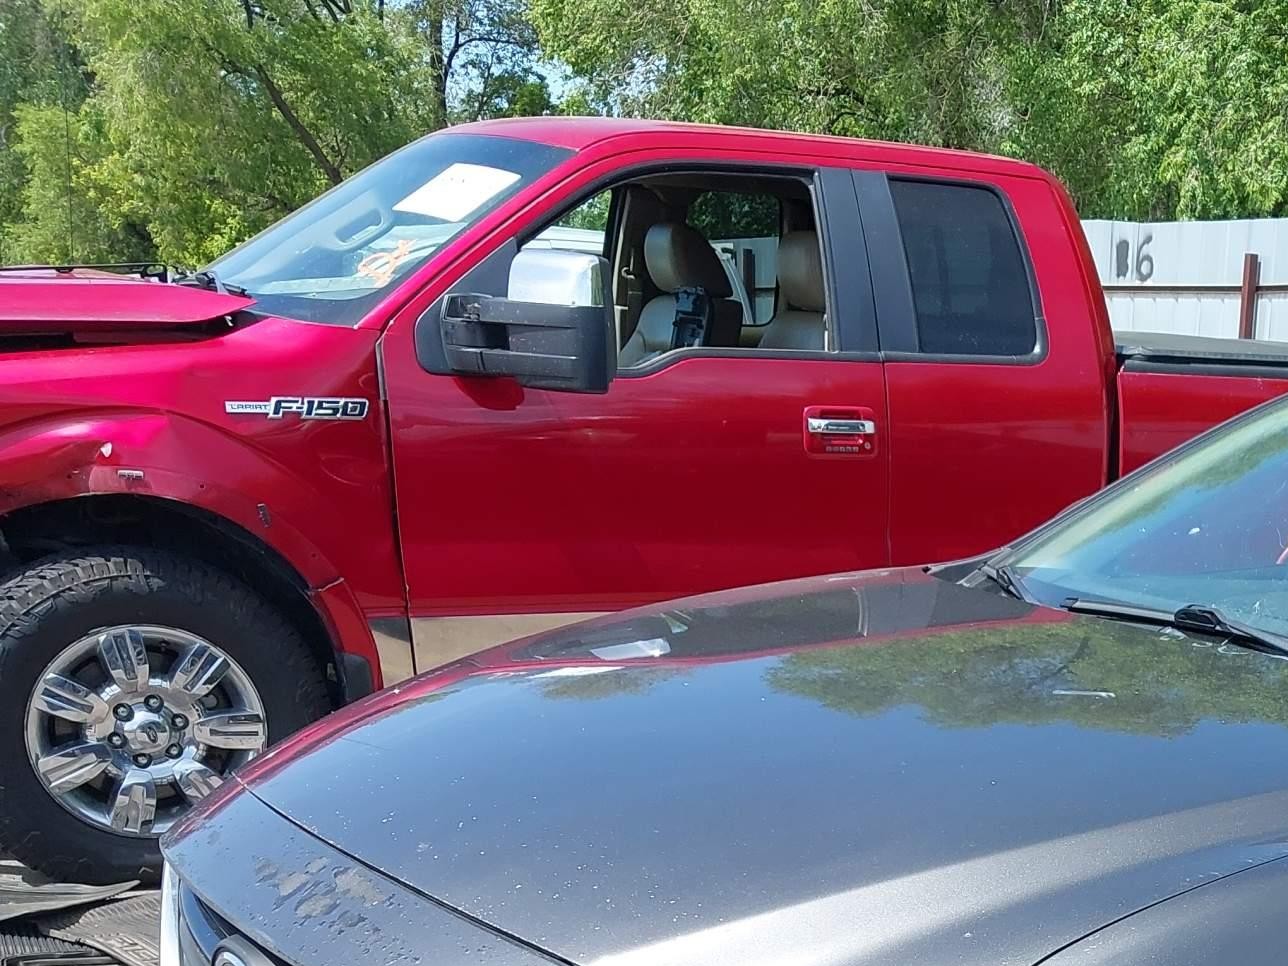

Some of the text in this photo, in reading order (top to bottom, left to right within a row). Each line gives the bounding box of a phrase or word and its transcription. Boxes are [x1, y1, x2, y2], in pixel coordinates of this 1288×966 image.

[1136, 235, 1153, 281] 6
[229, 398, 368, 418] LARIAT F-150
